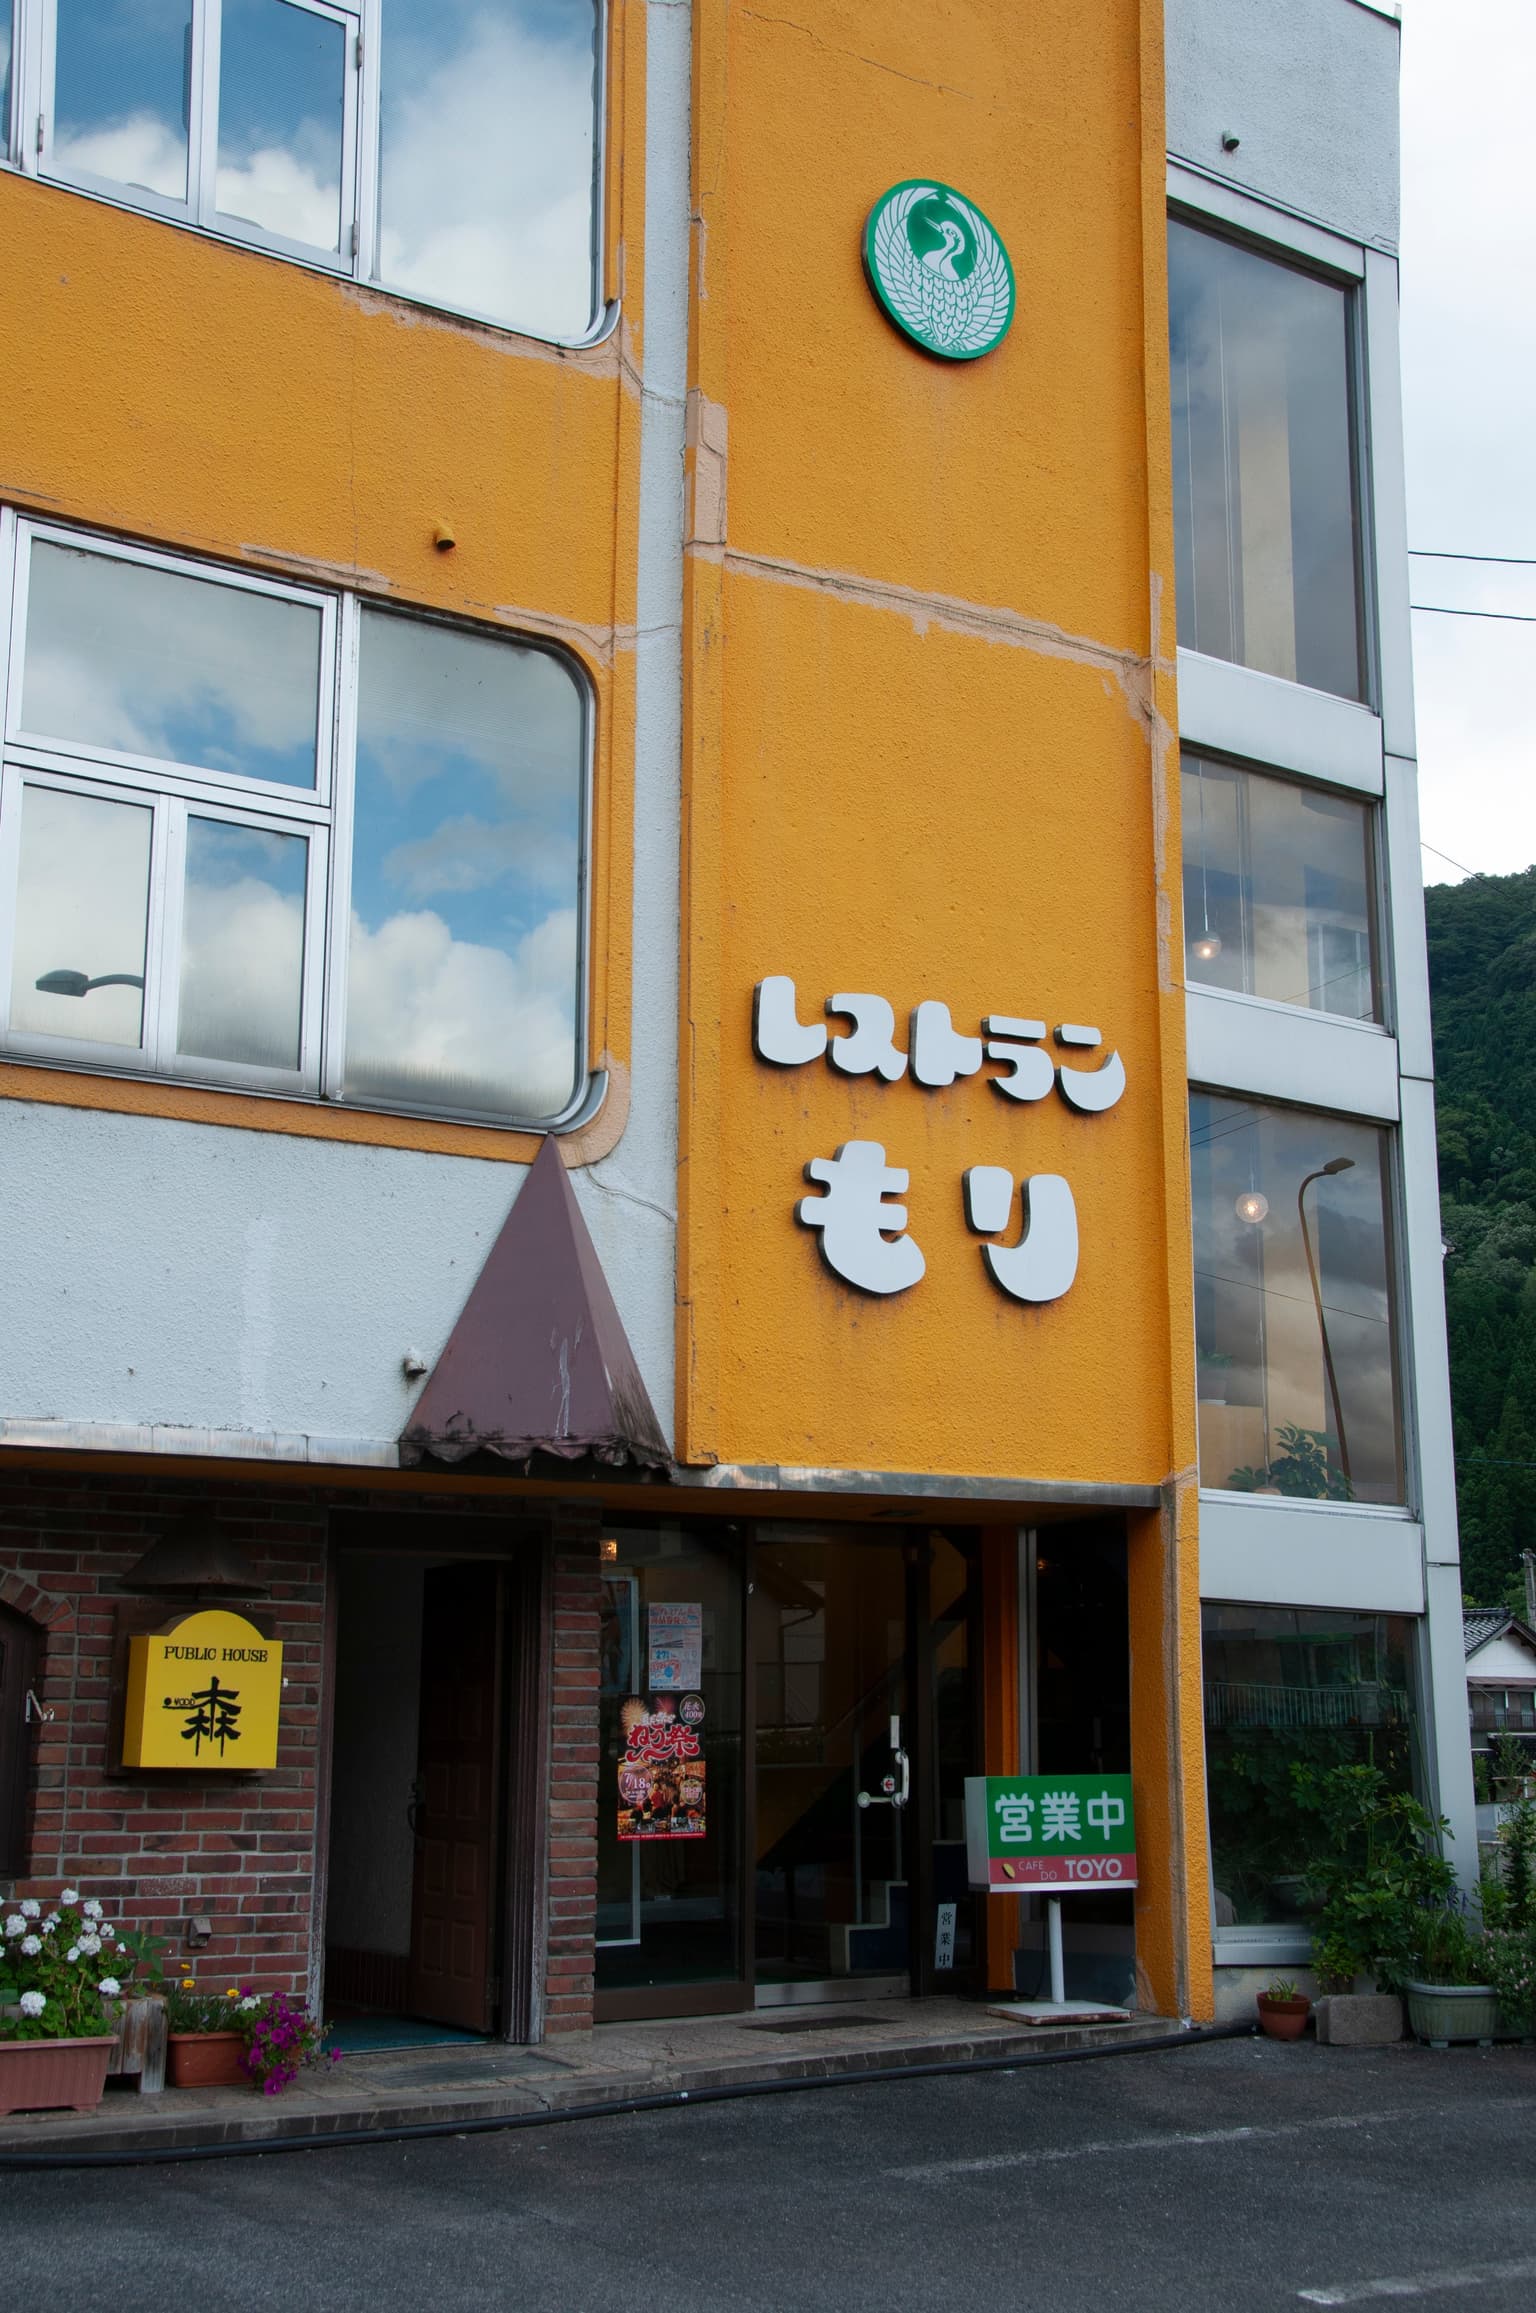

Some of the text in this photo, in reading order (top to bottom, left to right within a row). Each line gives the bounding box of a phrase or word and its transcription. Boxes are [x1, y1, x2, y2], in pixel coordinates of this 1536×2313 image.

[753, 975, 1126, 1112] レストラン
[795, 1140, 1080, 1302] もり
[164, 1646, 268, 1662] PUBLIC HOUSE
[163, 1676, 242, 1757] 森
[994, 1790, 1125, 1843] 営業中
[1018, 1860, 1045, 1872] CAFE
[1040, 1870, 1058, 1881] DO
[1064, 1858, 1123, 1879] TOYO
[939, 1911, 953, 1966] 営業中
